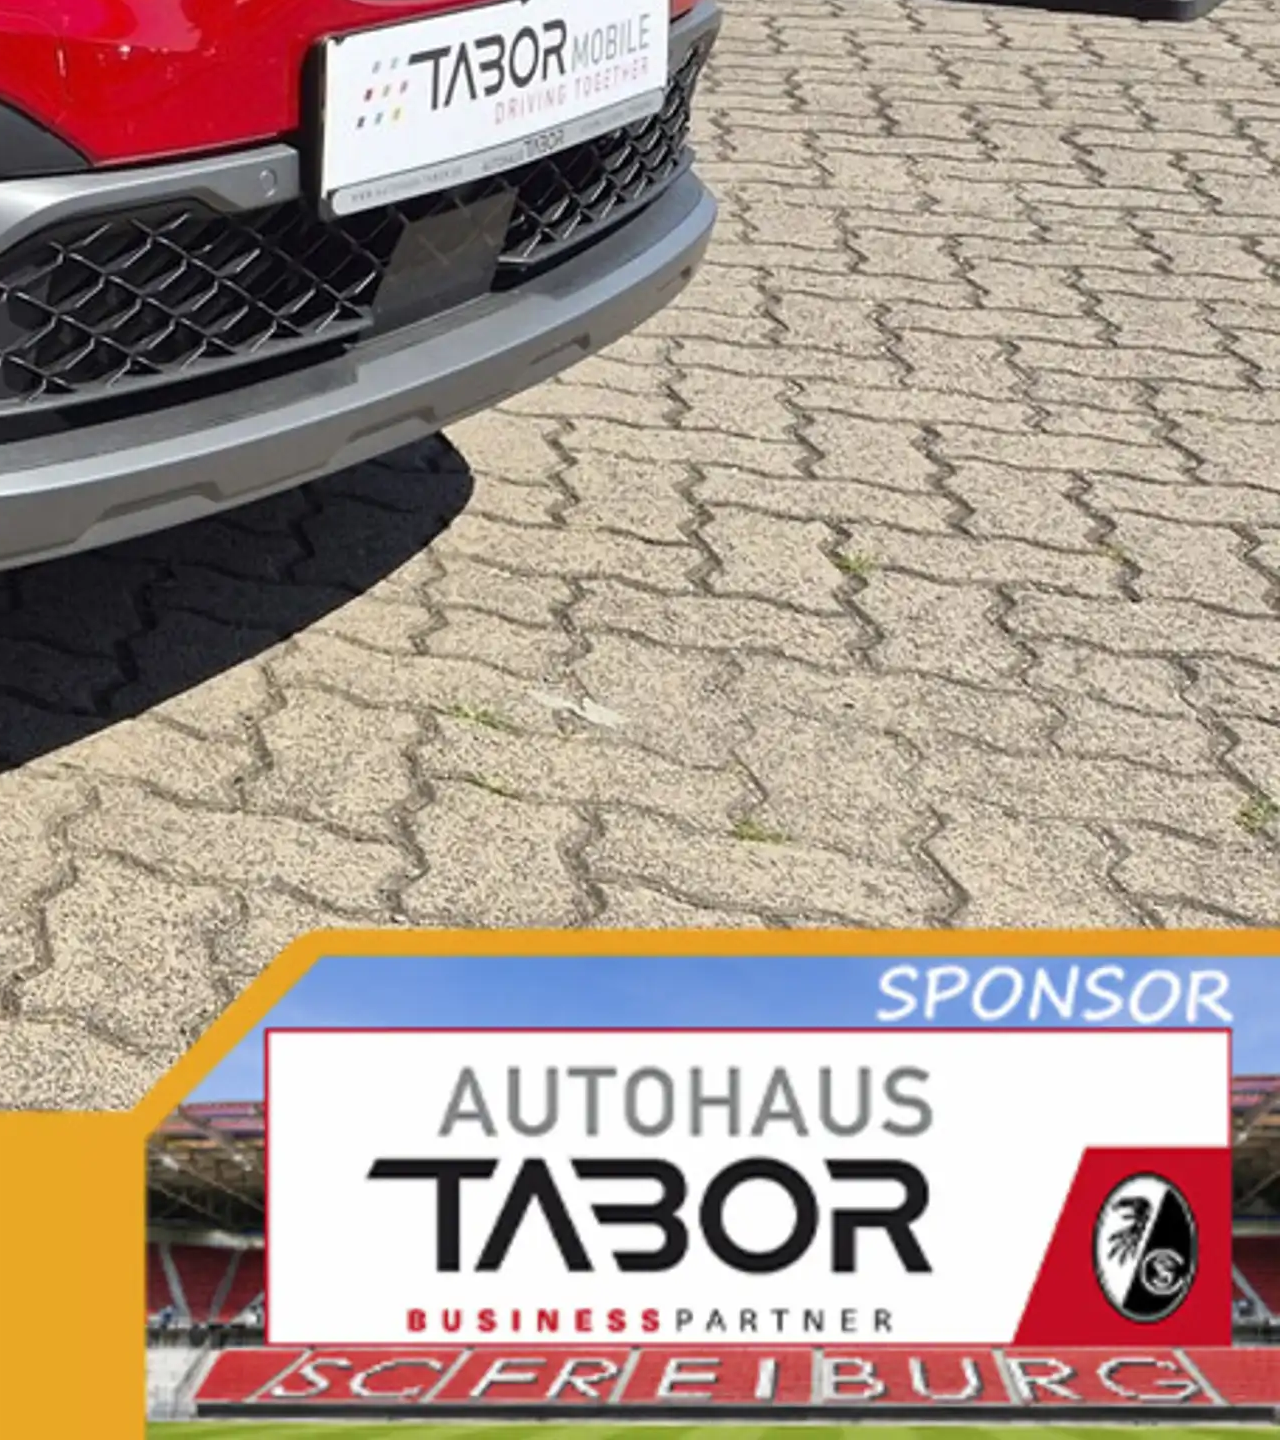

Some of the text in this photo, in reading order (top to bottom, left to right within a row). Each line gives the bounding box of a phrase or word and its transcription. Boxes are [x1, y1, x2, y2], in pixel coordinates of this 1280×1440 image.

[408, 13, 651, 111] TABOR MOBILE
[494, 90, 567, 126] DRIVING
[574, 58, 650, 101] TOGETHER
